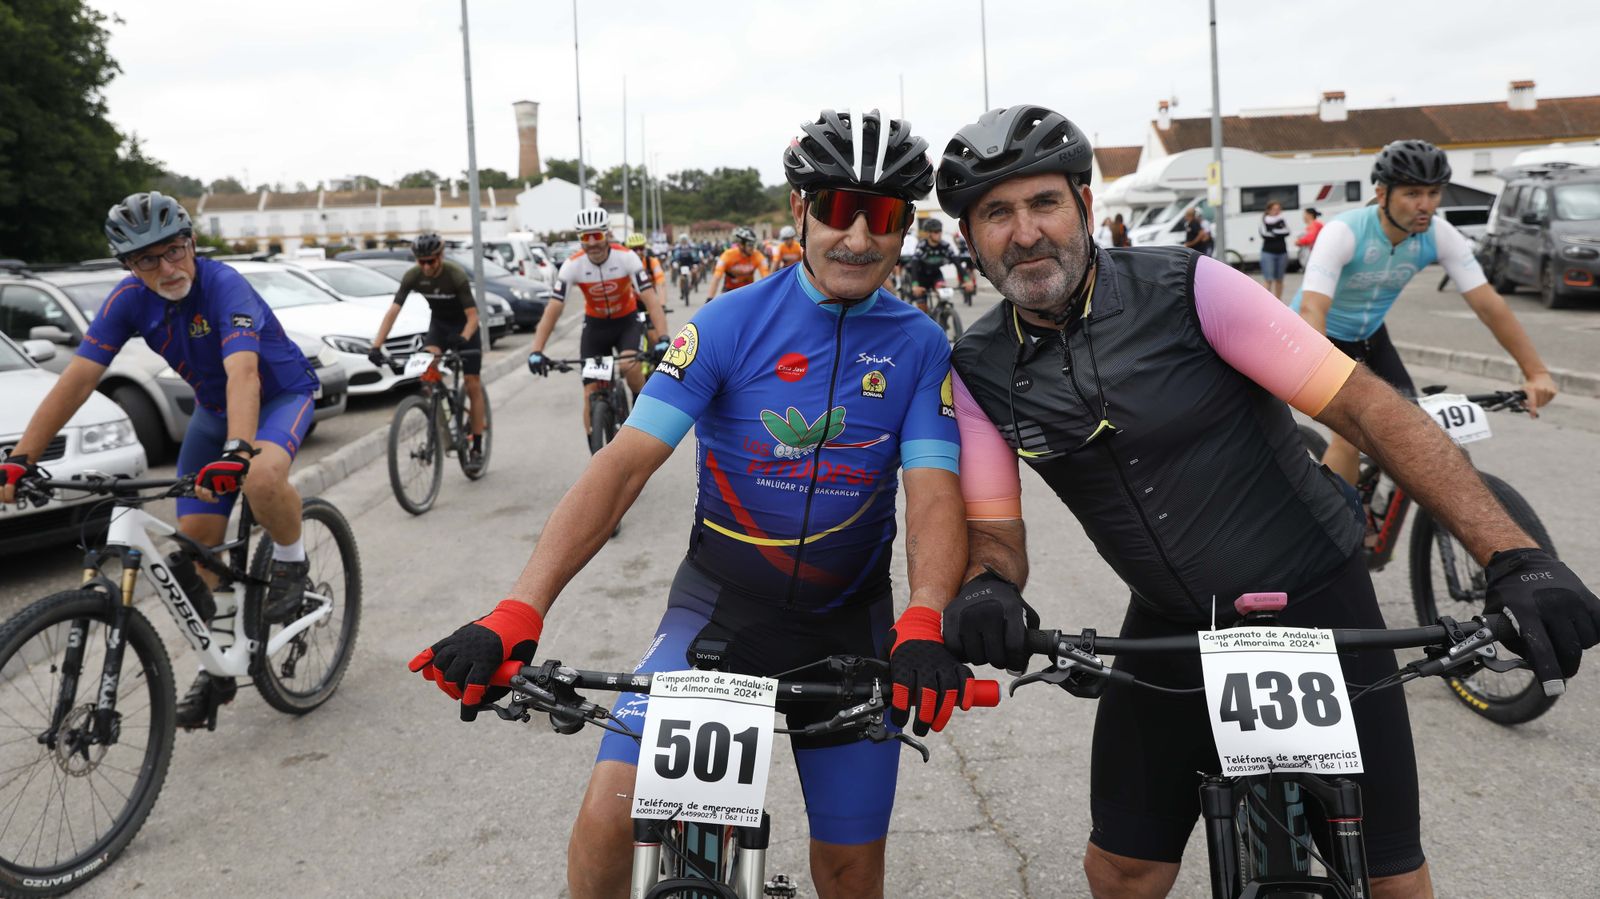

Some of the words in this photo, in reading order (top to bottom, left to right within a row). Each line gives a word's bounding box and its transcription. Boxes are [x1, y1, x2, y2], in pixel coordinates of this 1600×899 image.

[1437, 404, 1475, 429] 197
[743, 436, 771, 457] LOS
[756, 478, 796, 491] SANLÚCAR
[799, 486, 809, 494] DE
[1520, 571, 1554, 582] GORE
[150, 563, 211, 651] ORBEA
[1203, 631, 1261, 641] Campeonato
[1265, 630, 1277, 638] de
[1220, 640, 1229, 648] la
[1233, 639, 1285, 648] Almoraima
[1289, 639, 1315, 648] 2024
[713, 676, 725, 685] de
[669, 684, 678, 692] la
[681, 684, 730, 695] Almoraima
[734, 687, 757, 699] 2024
[1219, 670, 1342, 732] 438
[615, 707, 646, 719] Spiu
[851, 704, 866, 715] XT
[654, 718, 759, 785] 501
[1224, 755, 1272, 764] Teléfonos
[1276, 753, 1288, 761] de
[1292, 750, 1357, 763] emergencias
[638, 798, 683, 809] Teléfonos
[687, 801, 699, 810] de
[702, 803, 759, 815] emergencias
[680, 811, 718, 819] 645990275
[23, 873, 73, 887] BARZO
